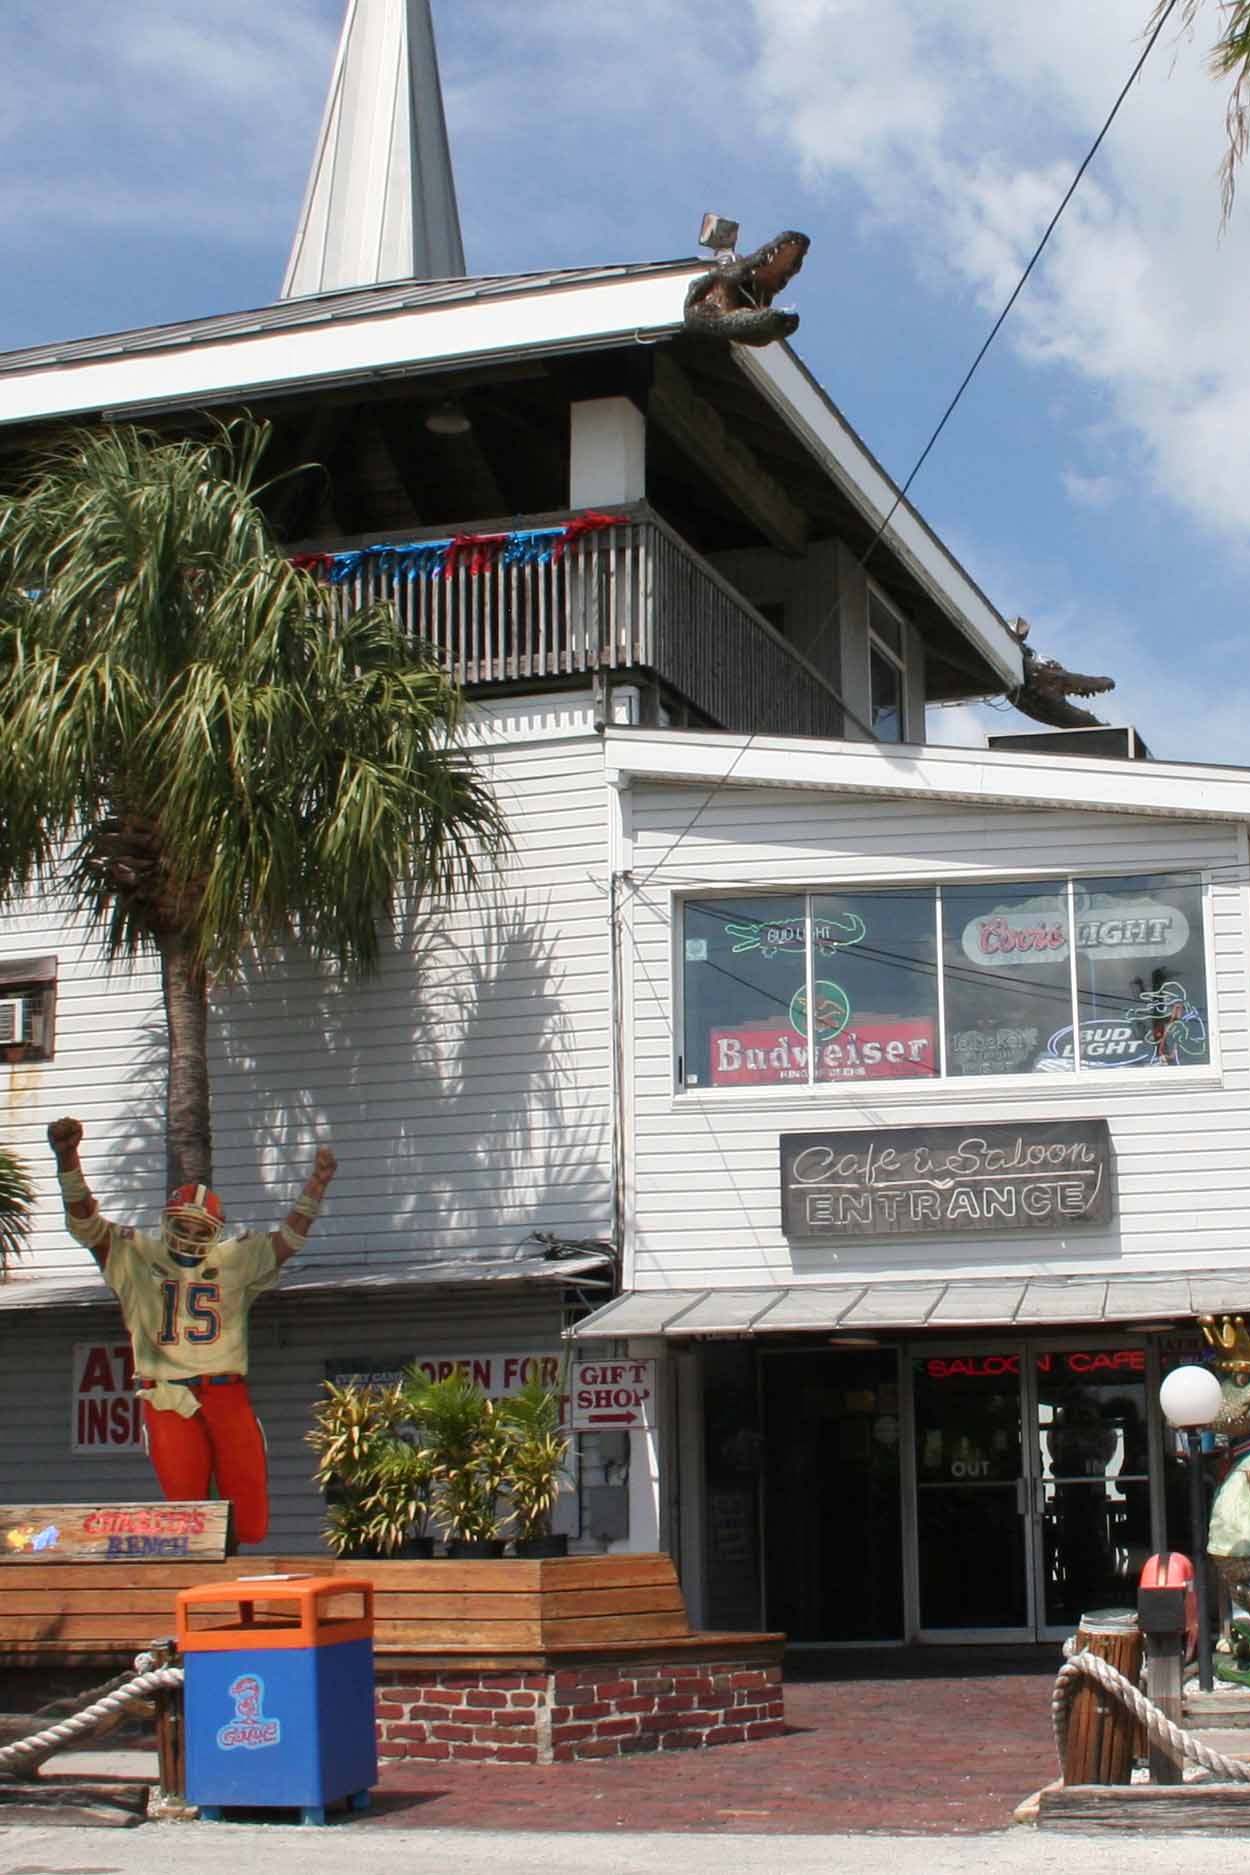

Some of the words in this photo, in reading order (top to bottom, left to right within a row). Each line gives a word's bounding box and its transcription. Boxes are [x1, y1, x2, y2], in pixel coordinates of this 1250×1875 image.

[767, 927, 793, 943] BUD
[975, 917, 1065, 954] Coors
[1076, 917, 1172, 947] LIGHT
[1080, 1028, 1133, 1042] BUD
[716, 1033, 929, 1073] Budweiser
[793, 1143, 900, 1184] Cafe
[944, 1137, 1095, 1175] Saloon
[806, 1181, 1086, 1225] ENTRANCE
[157, 1279, 222, 1346] 15
[420, 1359, 492, 1389] OPEN
[504, 1356, 560, 1388] FOR
[580, 1364, 648, 1386] GIFT
[1069, 1352, 1145, 1373] CAFE
[577, 1387, 650, 1409] SHOP
[951, 1459, 990, 1477] OUT
